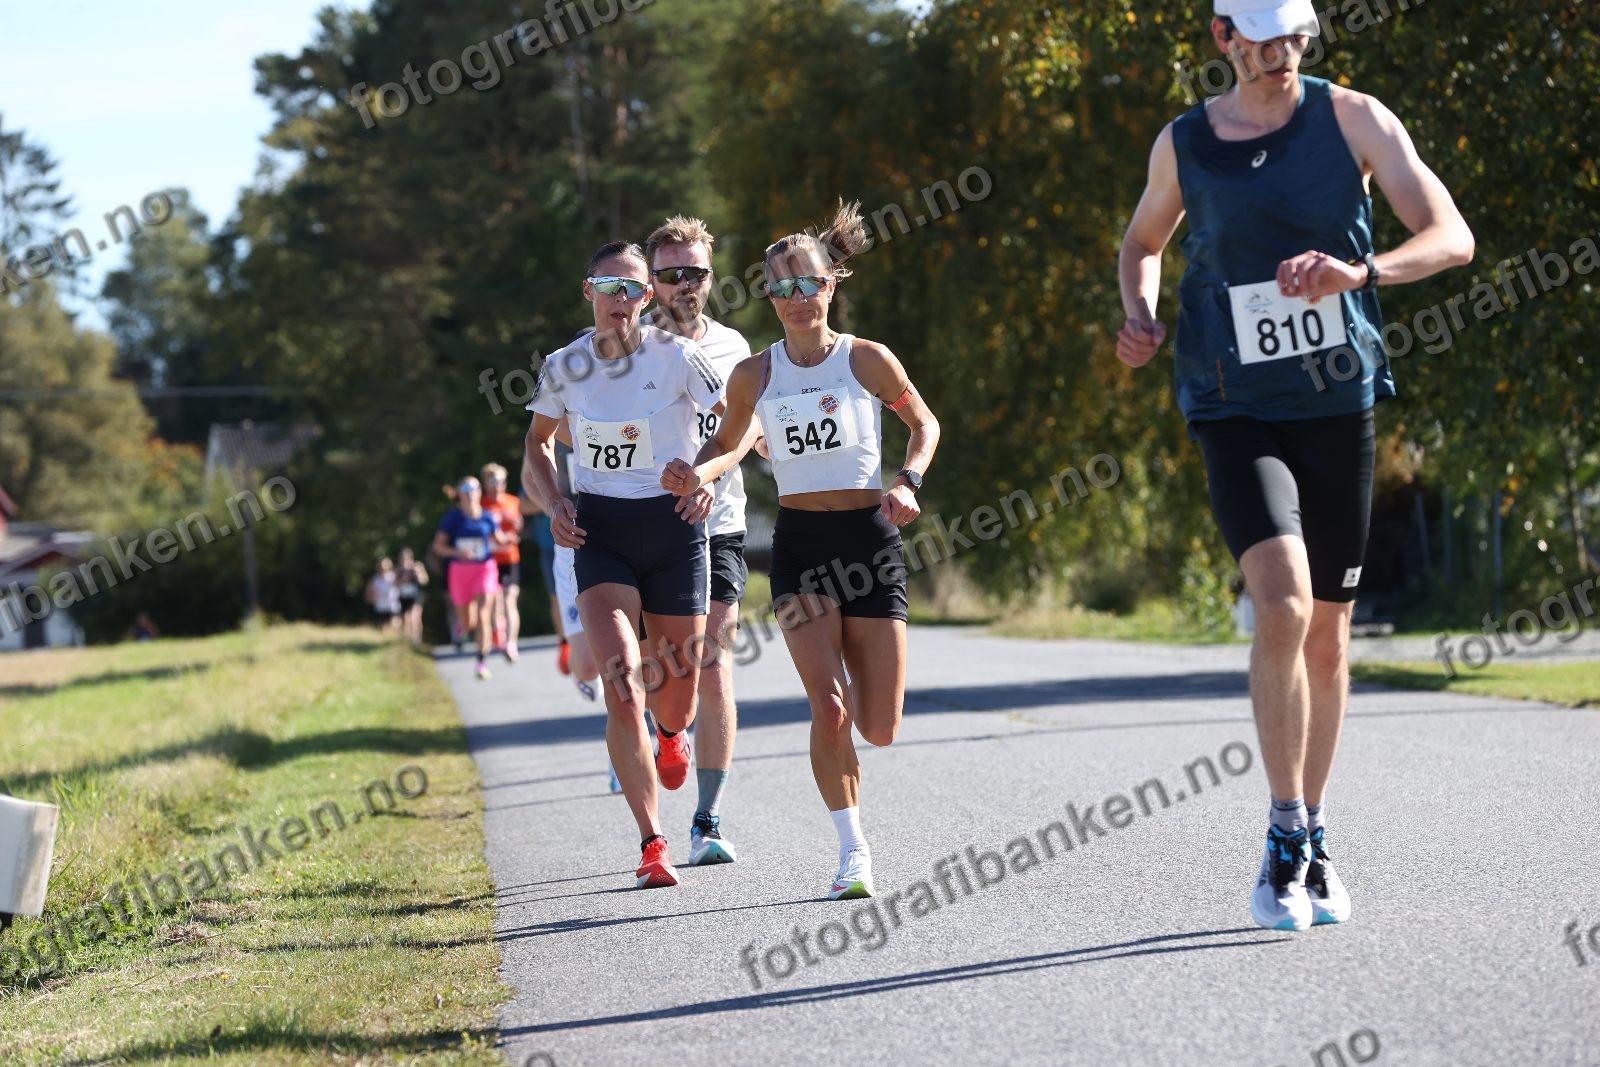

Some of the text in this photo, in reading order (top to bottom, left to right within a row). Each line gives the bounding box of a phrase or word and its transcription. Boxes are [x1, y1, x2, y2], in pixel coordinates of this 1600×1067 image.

[1257, 309, 1324, 356] 810
[785, 418, 842, 455] 542
[587, 443, 637, 470] 787
